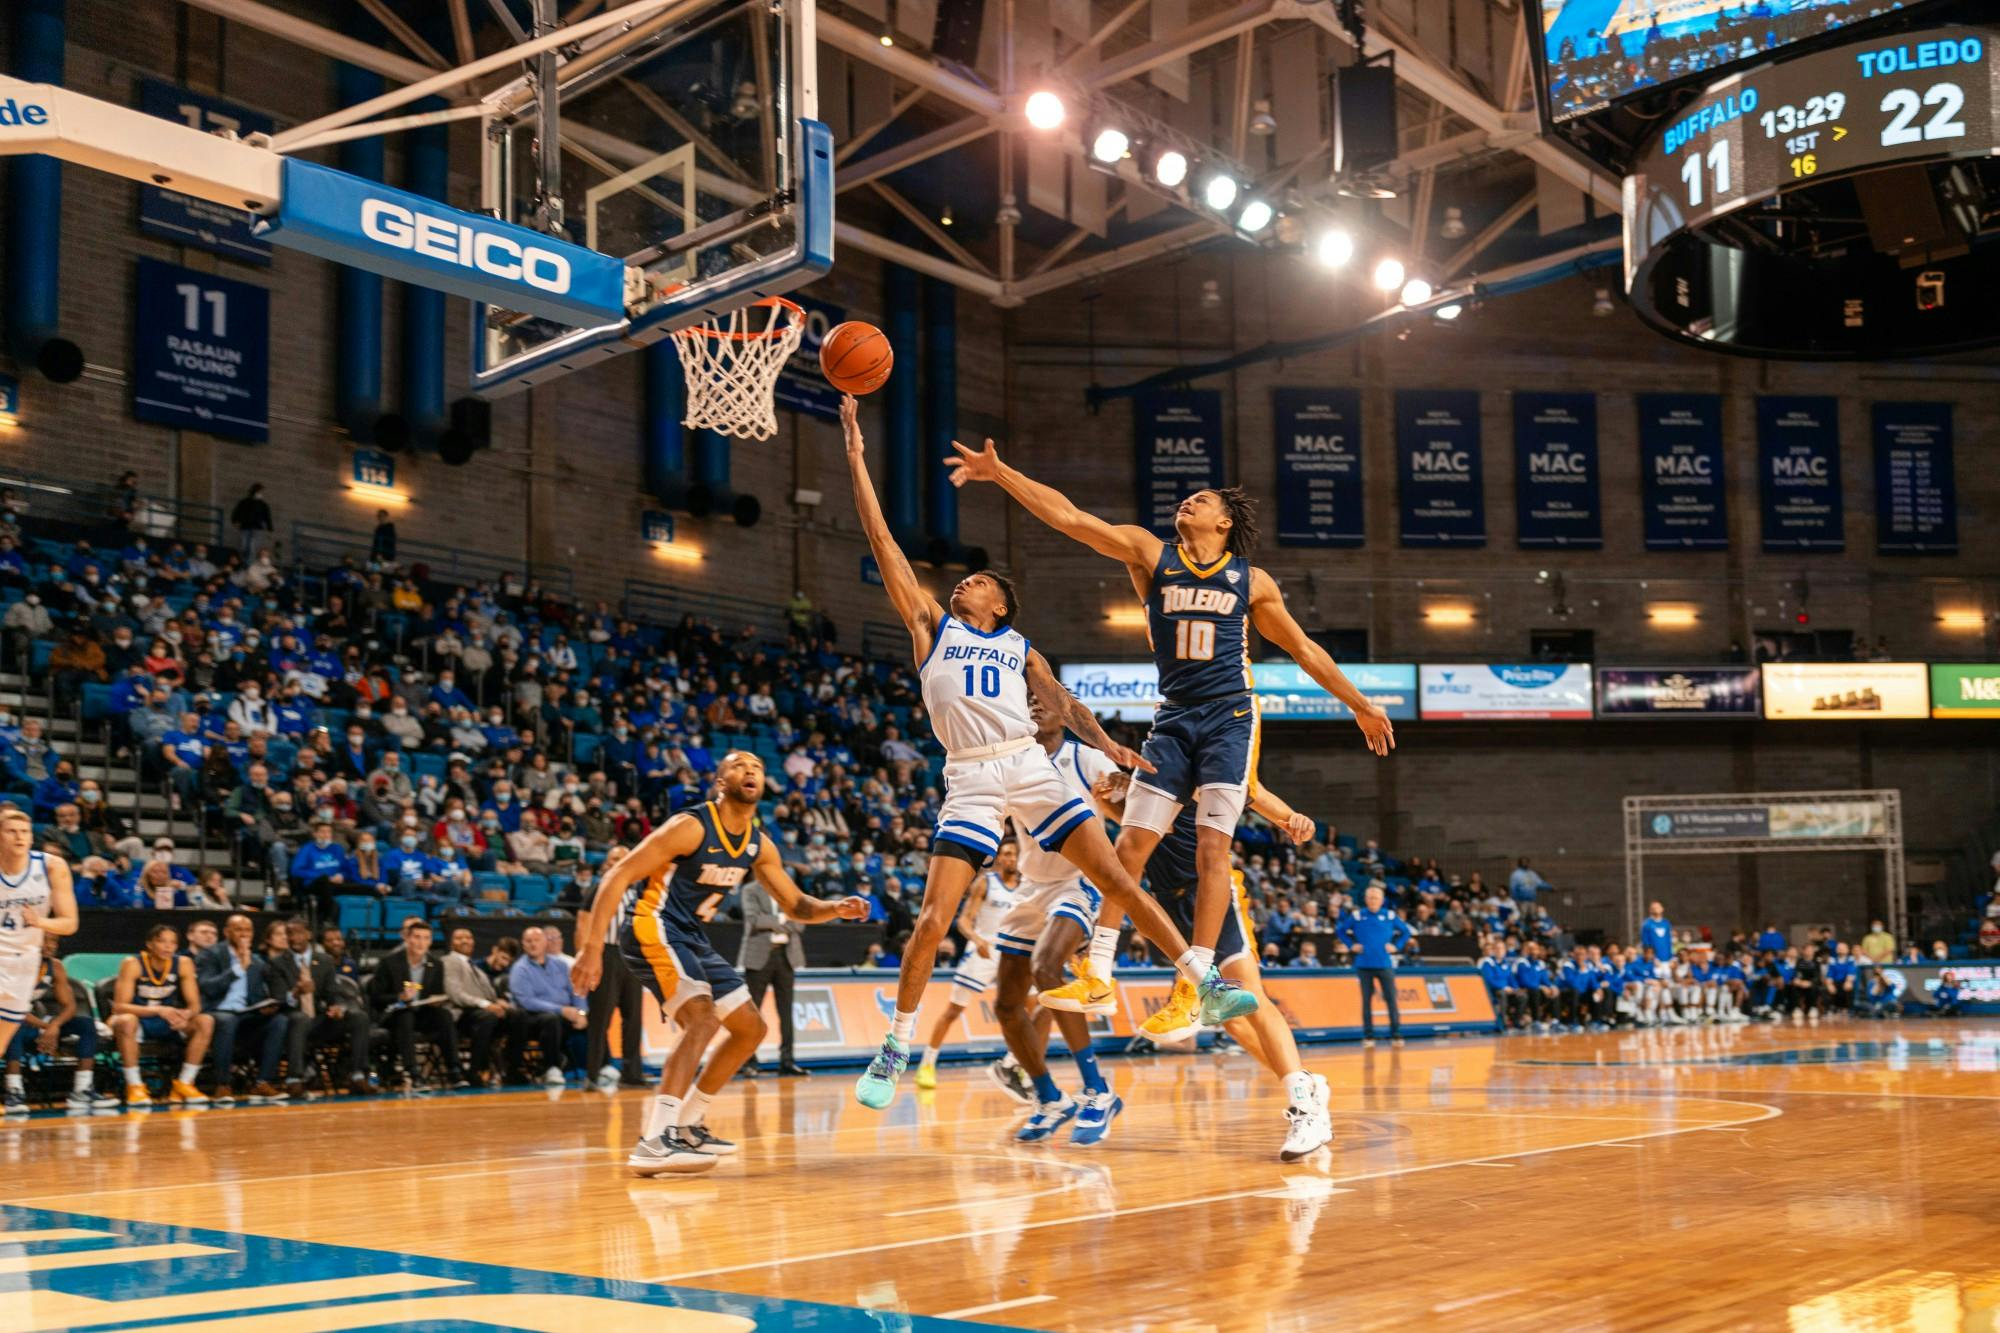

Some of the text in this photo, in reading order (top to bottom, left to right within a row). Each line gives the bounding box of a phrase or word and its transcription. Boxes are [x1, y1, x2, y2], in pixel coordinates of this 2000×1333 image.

[1856, 38, 1982, 78] TOLEDO
[1664, 88, 1757, 155] BUFFALO
[1760, 92, 1846, 138] 13:29
[1880, 82, 1966, 146] 22
[1785, 131, 1820, 155] 1ST
[1681, 138, 1730, 207] 11
[1790, 154, 1817, 178] 16
[361, 198, 570, 294] GEICO
[176, 283, 227, 337] 11
[166, 335, 243, 365] RASAUN
[171, 352, 238, 379] YOUNG
[1154, 437, 1205, 454] MAC
[1294, 435, 1345, 452] MAC
[1411, 451, 1469, 472] MAC
[1529, 452, 1586, 473] MAC
[1654, 455, 1711, 475] MAC
[1772, 456, 1828, 476] MAC
[1160, 585, 1238, 616] TOLEDO
[1175, 619, 1216, 661] 10
[943, 646, 1019, 671] BUFFALO
[962, 665, 1001, 698] 10
[694, 892, 724, 923] 4
[792, 1002, 831, 1031] CAT
